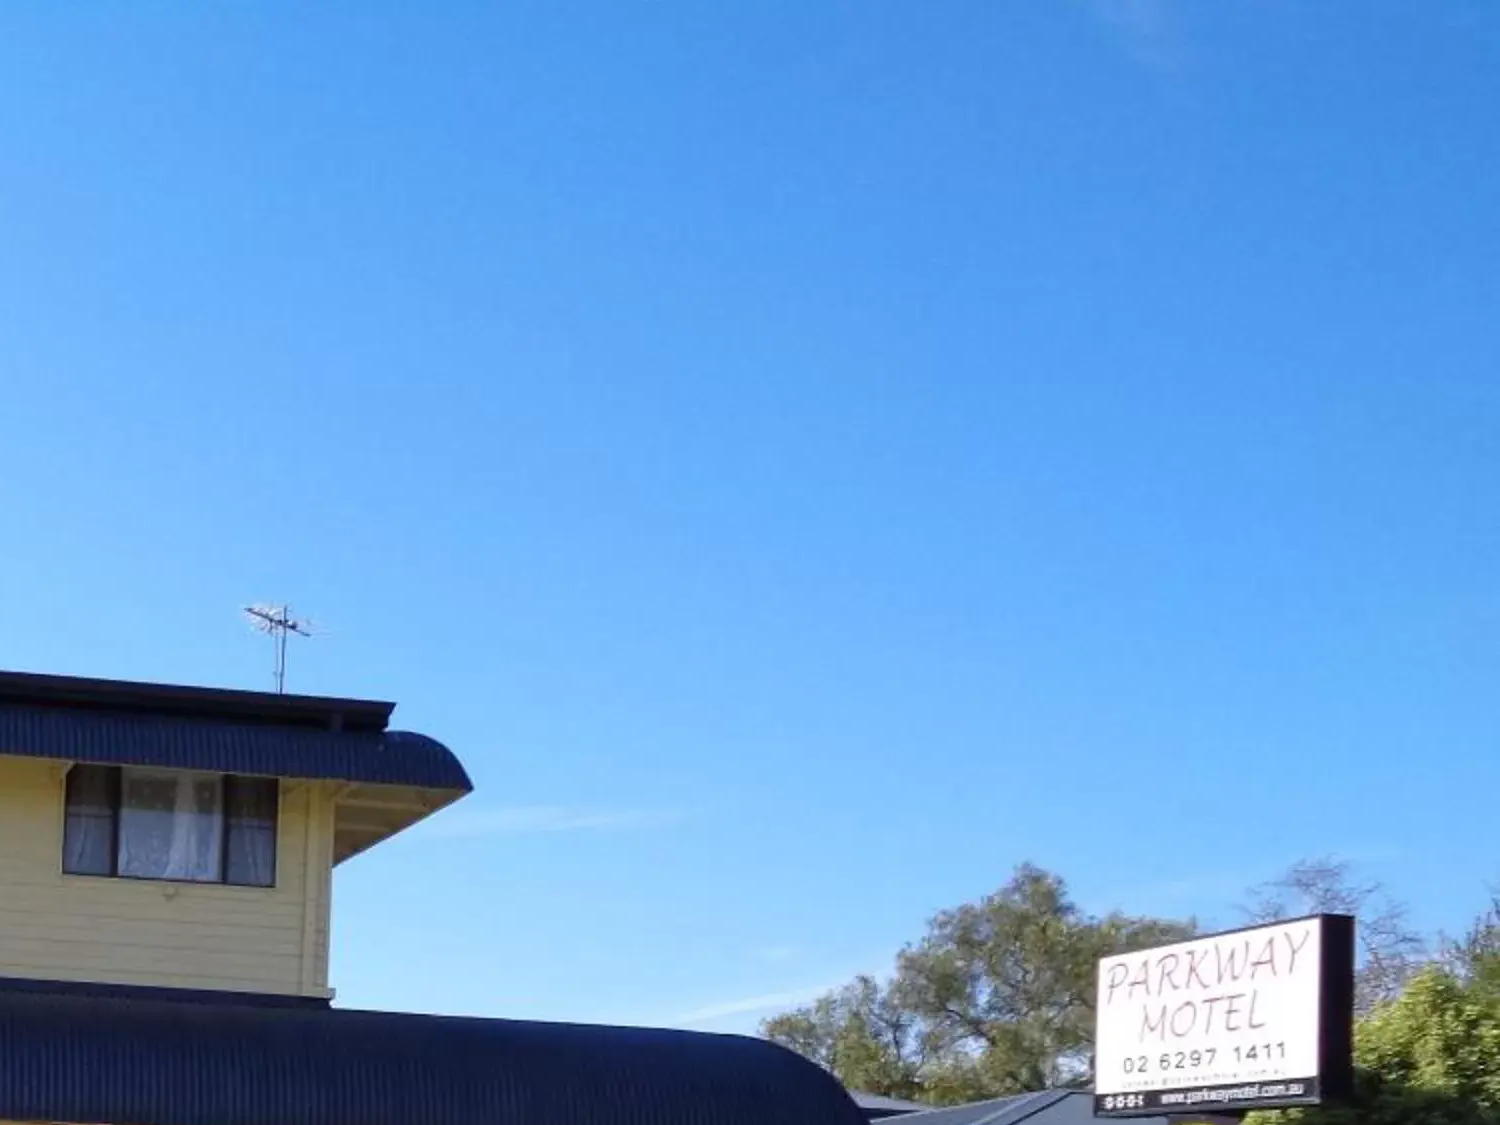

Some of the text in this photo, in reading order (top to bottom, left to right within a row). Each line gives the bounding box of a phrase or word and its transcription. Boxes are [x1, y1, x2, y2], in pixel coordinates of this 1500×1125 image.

[1106, 929, 1311, 1005] PARKWAY
[1139, 989, 1267, 1043] MOTEL
[1123, 1040, 1287, 1075] 02 6297 1411
